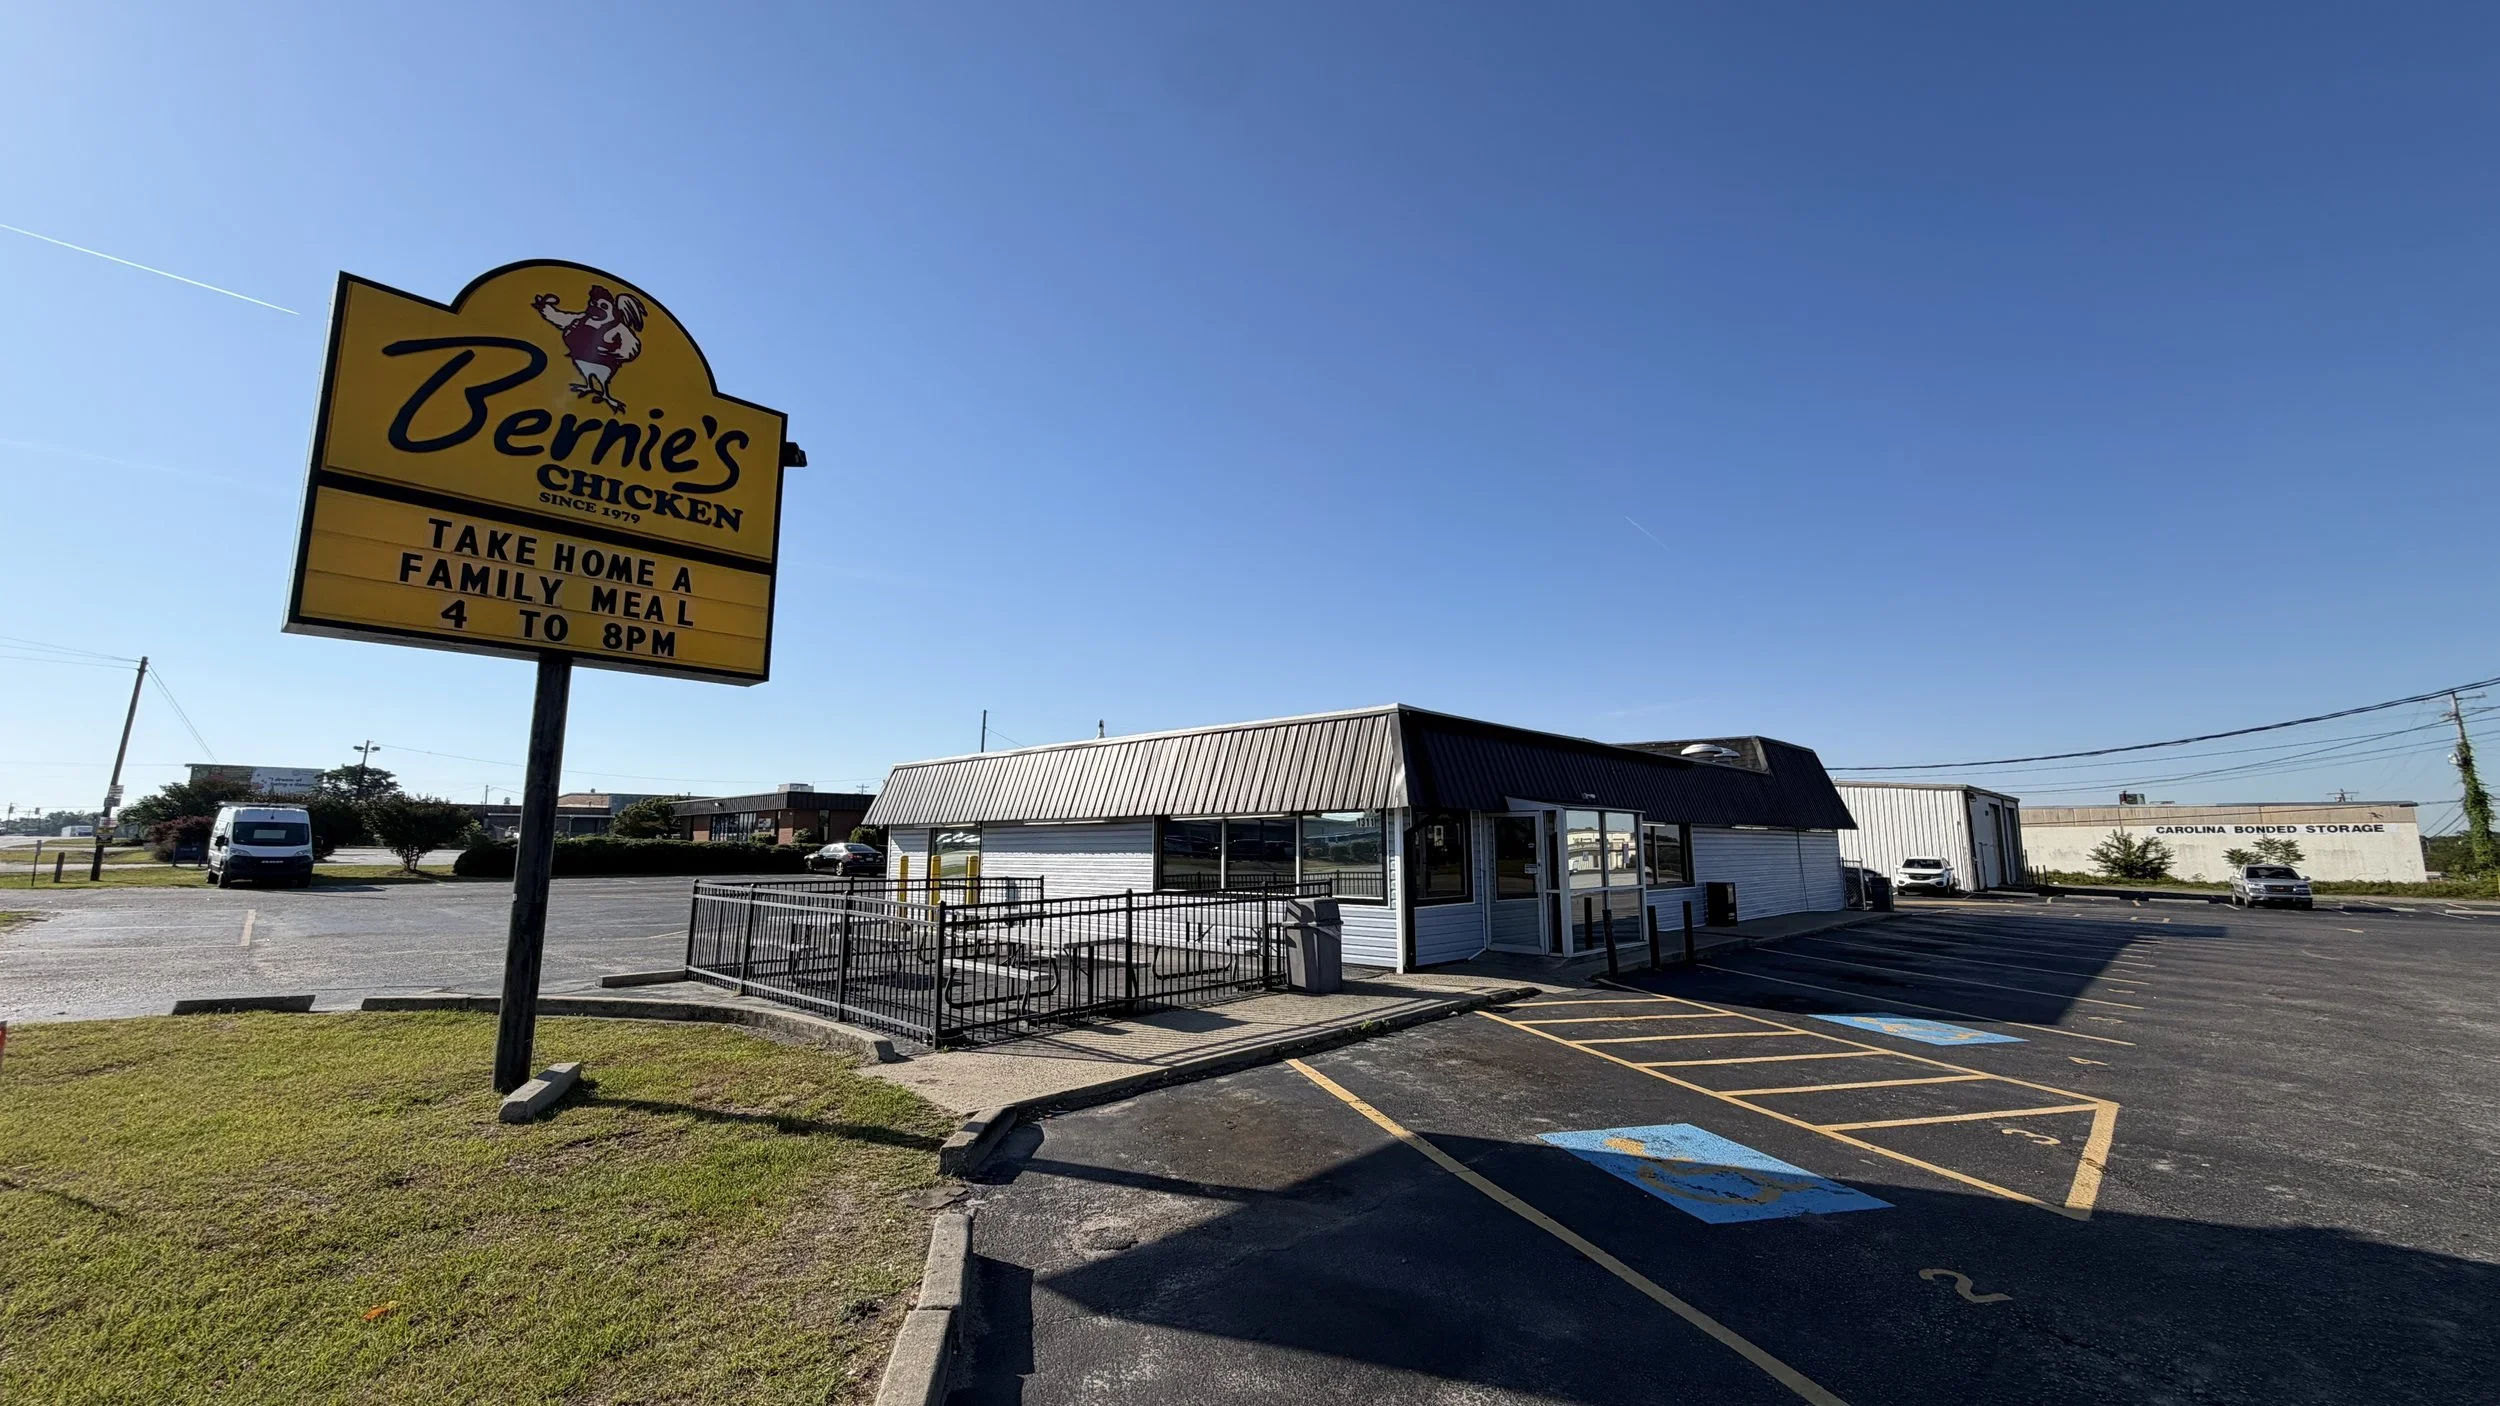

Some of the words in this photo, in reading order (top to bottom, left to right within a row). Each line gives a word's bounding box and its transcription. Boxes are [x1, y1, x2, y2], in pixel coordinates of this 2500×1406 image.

[382, 336, 749, 494] Bernie's
[537, 464, 743, 533] CHICKEN
[539, 491, 597, 514] SINCE
[602, 507, 640, 524] 1979
[428, 518, 537, 566] TAKE
[553, 543, 655, 587] HOME
[672, 567, 692, 594] A
[400, 552, 564, 606] FAMILY
[591, 585, 694, 627] MEAL
[441, 600, 467, 629] 4
[519, 609, 569, 642] TO
[602, 622, 676, 657] 8PM
[1357, 817, 1375, 827] 1311
[2156, 826, 2226, 834] CAROLINA
[2234, 825, 2297, 834] BONDED
[2306, 824, 2385, 833] STORAGE
[2001, 1128, 2061, 1145] 3
[1918, 1268, 2013, 1304] 2
